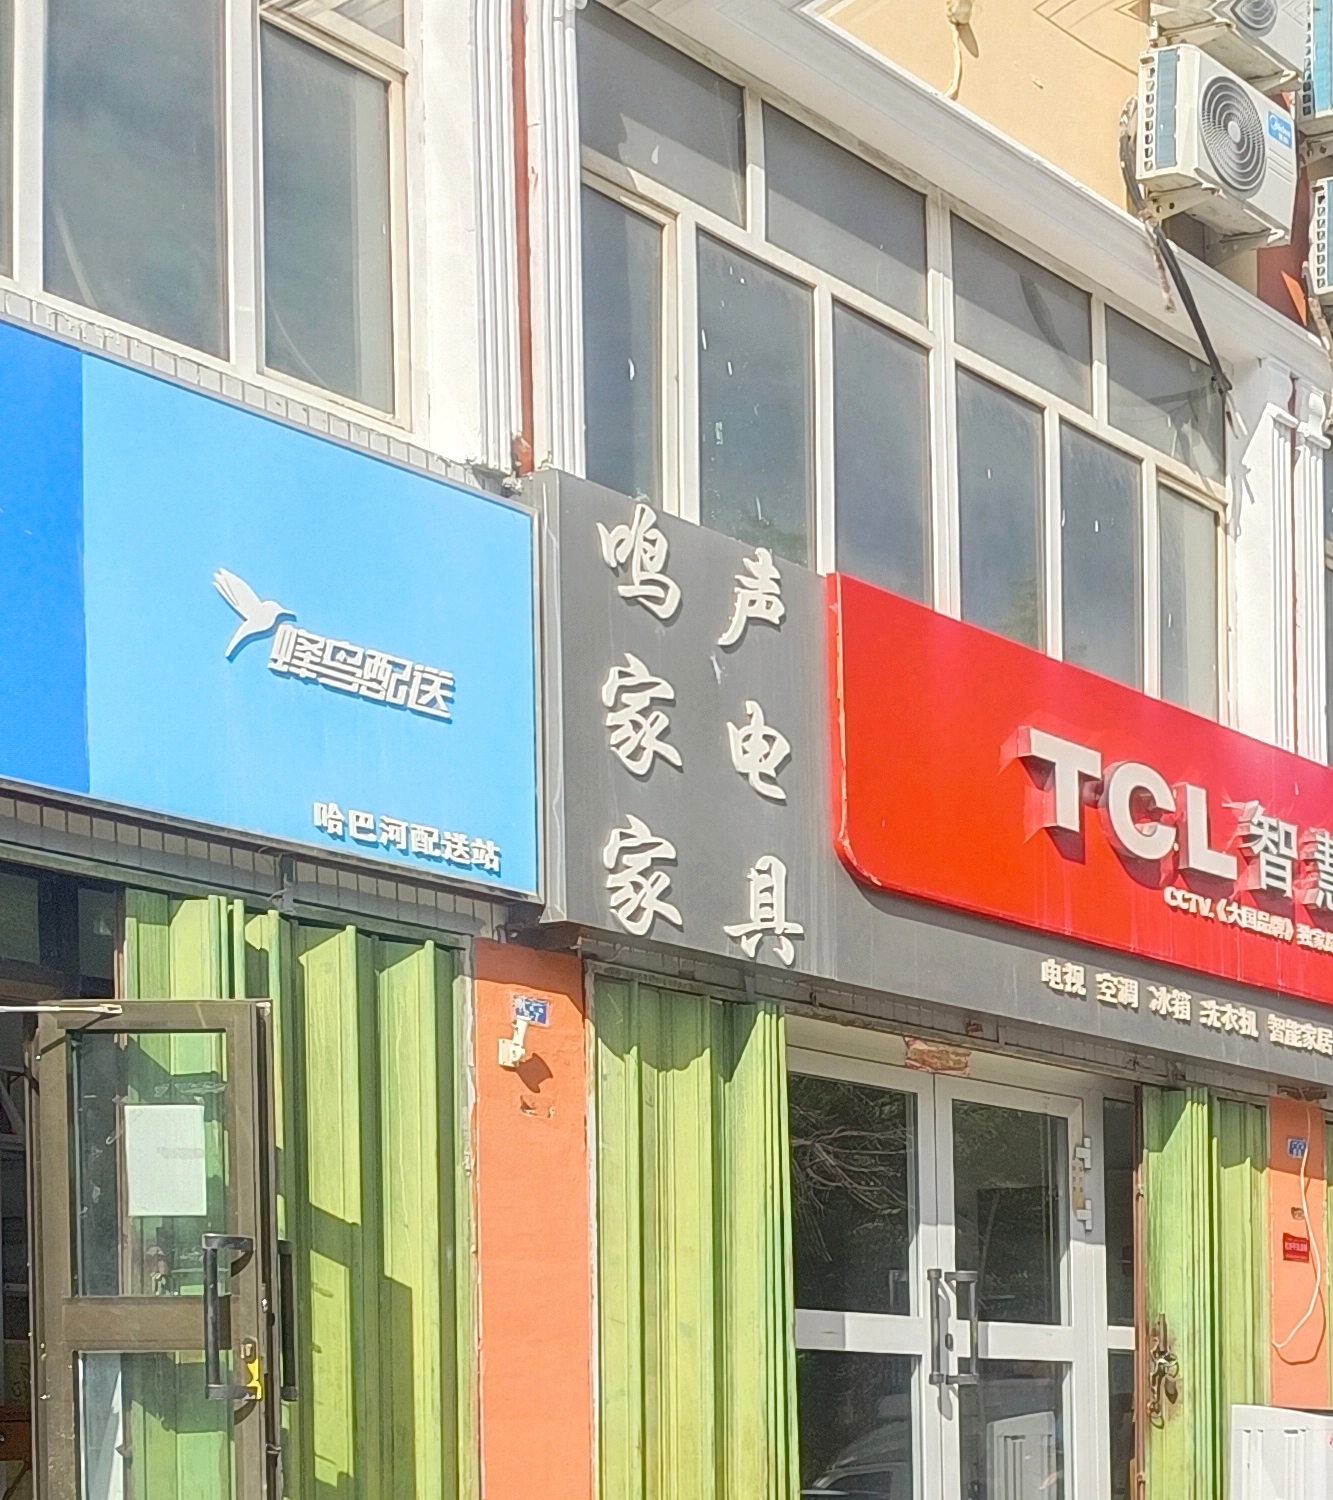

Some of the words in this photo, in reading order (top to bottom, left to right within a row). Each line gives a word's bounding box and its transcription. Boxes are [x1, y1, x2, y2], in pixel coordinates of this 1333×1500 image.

[269, 622, 455, 723] 蜂鸟配送
[312, 800, 503, 874] 哈巴河配送站
[1018, 726, 1237, 881] TCL
[1040, 957, 1087, 997] 电视
[1096, 971, 1140, 1010] 空调
[1147, 983, 1192, 1021] 冰箱
[1199, 998, 1259, 1038] 洗衣机
